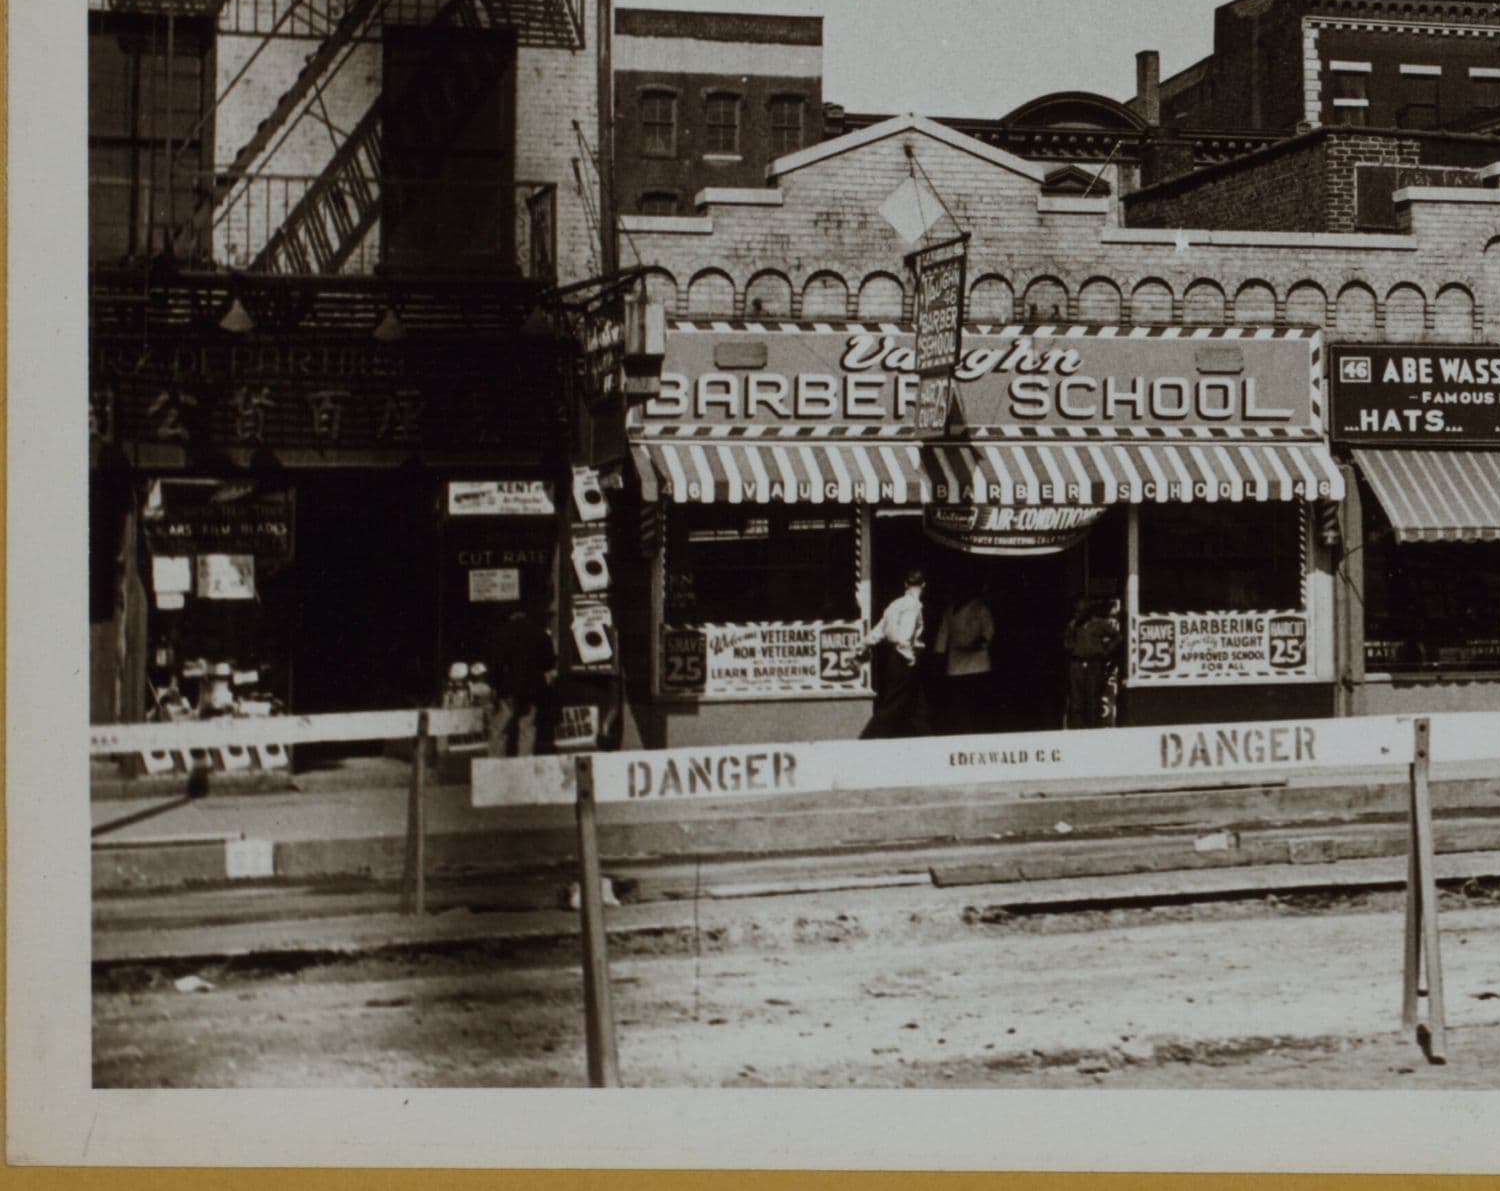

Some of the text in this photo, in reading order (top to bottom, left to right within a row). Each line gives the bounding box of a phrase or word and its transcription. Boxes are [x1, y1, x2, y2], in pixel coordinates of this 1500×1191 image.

[842, 334, 1082, 381] Vaghn
[1343, 361, 1368, 379] 46
[1382, 358, 1433, 384] ABE
[1009, 376, 1296, 421] SCHOOL
[1421, 391, 1496, 405] FAMOUS
[743, 481, 894, 500] VAUGHN
[935, 481, 1079, 500] BARBER
[1119, 481, 1256, 499] SCHOOL
[458, 550, 547, 565] CUT RATE
[1139, 623, 1175, 642] SHAVE
[1179, 618, 1265, 636] BARBERING
[760, 629, 817, 645] VETERANS
[1220, 635, 1263, 649] TAUGHT
[1181, 651, 1229, 663] APPROVED
[1231, 649, 1265, 661] SCHOOL
[711, 665, 817, 680] LEARN BARBERING
[1201, 662, 1246, 671] FOR ALL
[1160, 726, 1316, 768] DANGER
[627, 751, 797, 798] DANGER
